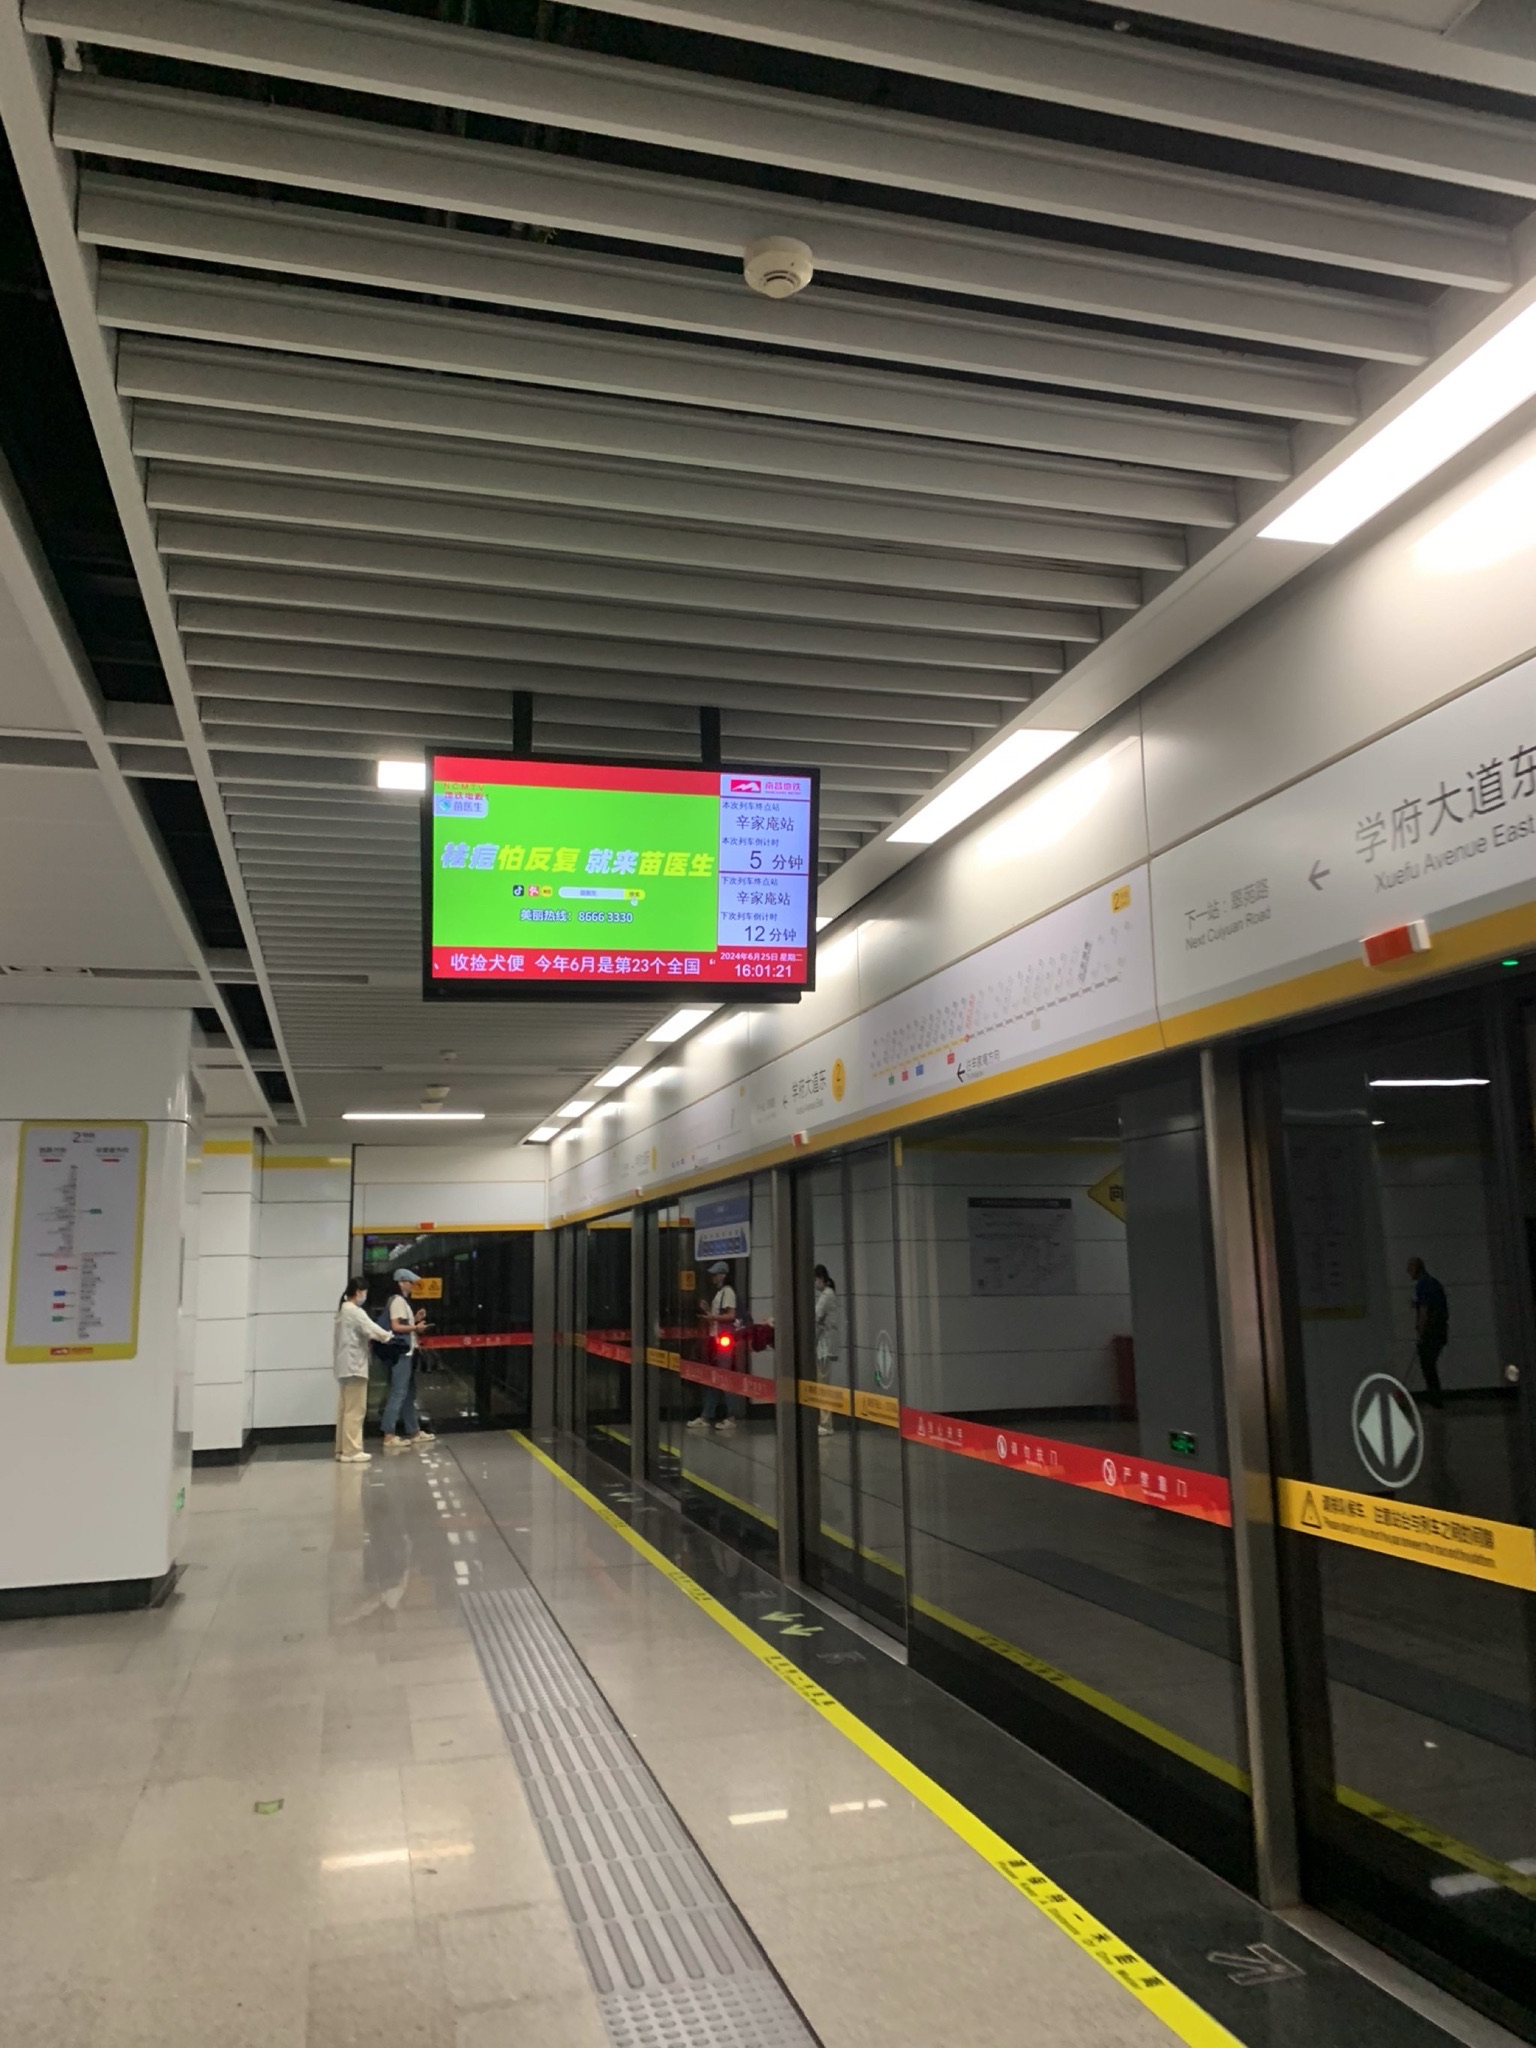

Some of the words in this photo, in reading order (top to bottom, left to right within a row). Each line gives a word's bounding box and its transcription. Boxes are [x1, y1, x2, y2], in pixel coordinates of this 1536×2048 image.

[443, 783, 486, 791] NCMTV
[765, 781, 801, 792] 南昌地铁
[454, 801, 483, 812] 苗医生
[722, 801, 780, 811] 本次列车终点站
[1354, 745, 1536, 863] 学府大道东
[736, 814, 795, 832] 辛家庵站
[722, 837, 780, 847] 本次列车倒计时
[440, 842, 581, 873] 祛痘怕反复
[585, 848, 715, 877] 就来苗医生
[749, 850, 763, 869] 5
[772, 854, 804, 871] 分钟
[1374, 861, 1421, 893] Xuefu
[1423, 835, 1488, 875] Avenue
[1491, 813, 1536, 849] East
[721, 876, 778, 886] 下次列车终点站
[737, 891, 791, 906] 辛家庵站
[1113, 892, 1120, 910] 2
[578, 911, 605, 923] 8666
[607, 912, 633, 923] 3330
[721, 911, 778, 922] 下次列车倒计时
[744, 925, 765, 942] 12
[769, 928, 797, 942] 分钟
[1185, 933, 1206, 951] Next
[1207, 919, 1244, 942] Cuiyuan
[1245, 905, 1271, 927] Road
[720, 952, 778, 962] 2024年6月25日
[779, 953, 803, 962] 星期二
[534, 955, 701, 975] 今年6月是第23个全国
[734, 963, 792, 978] 16:01:21
